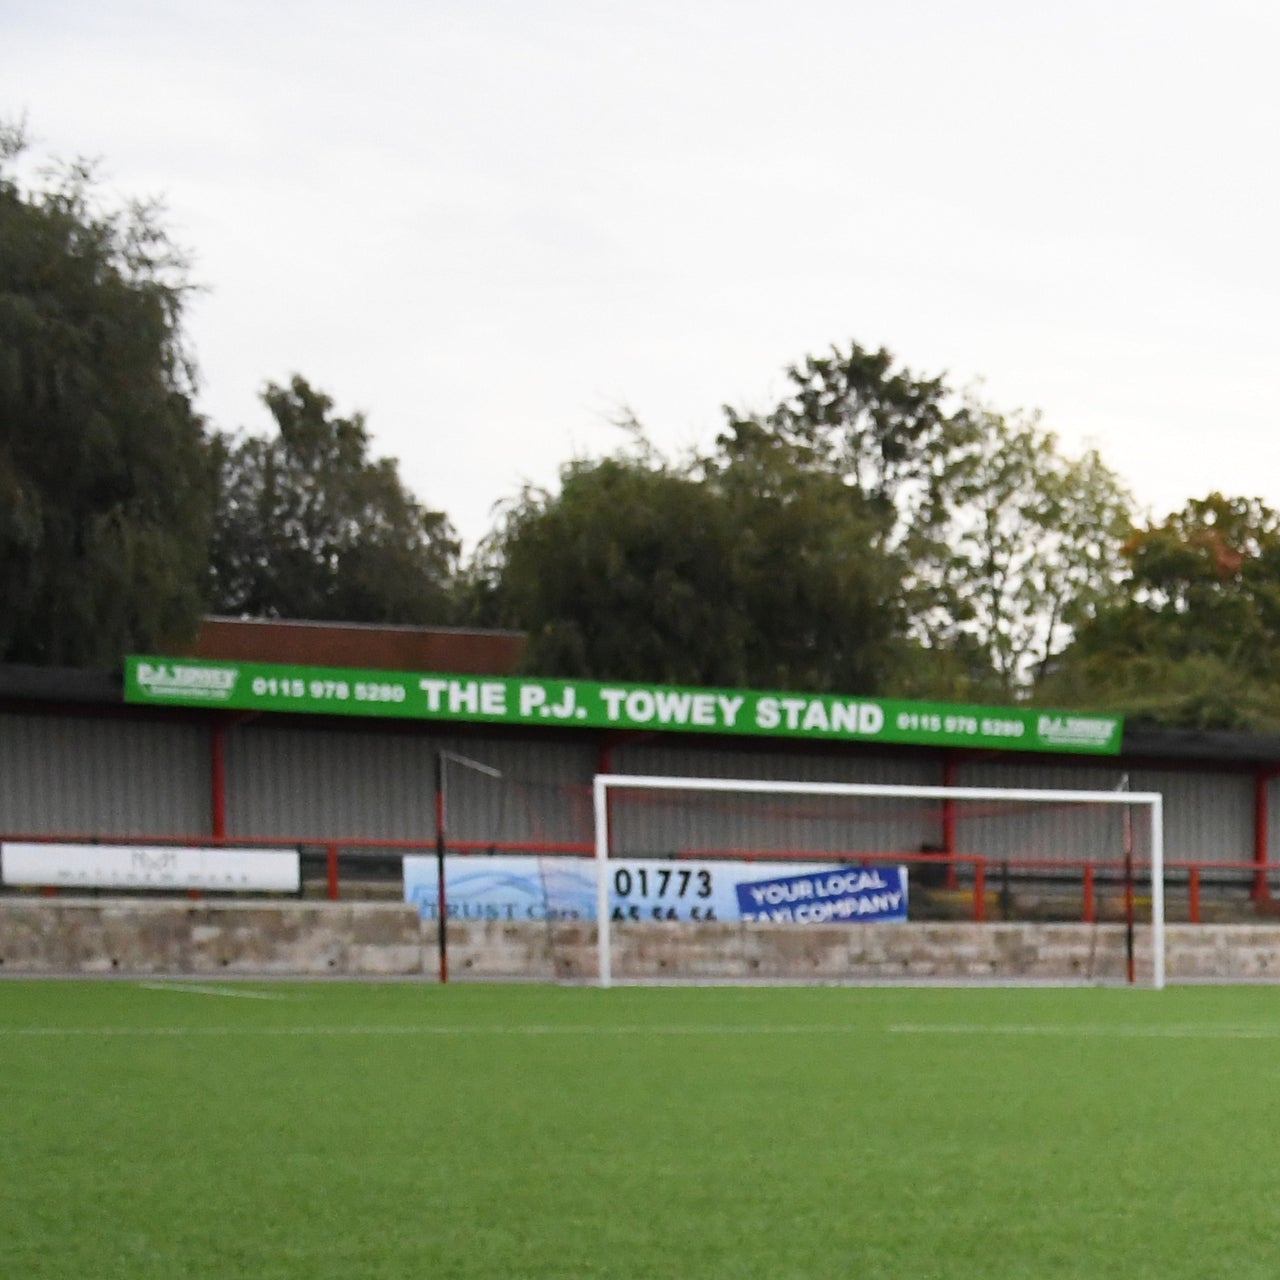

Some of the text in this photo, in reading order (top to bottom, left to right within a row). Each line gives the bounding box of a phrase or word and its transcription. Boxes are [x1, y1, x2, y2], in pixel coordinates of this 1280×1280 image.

[252, 677, 304, 697] 0115
[309, 680, 349, 699] 978
[419, 679, 885, 734] THE P.J. TOWEY STAND
[614, 868, 712, 899] 01773
[752, 870, 887, 906] YOUR LOCAL
[795, 892, 901, 924] COMPANY
